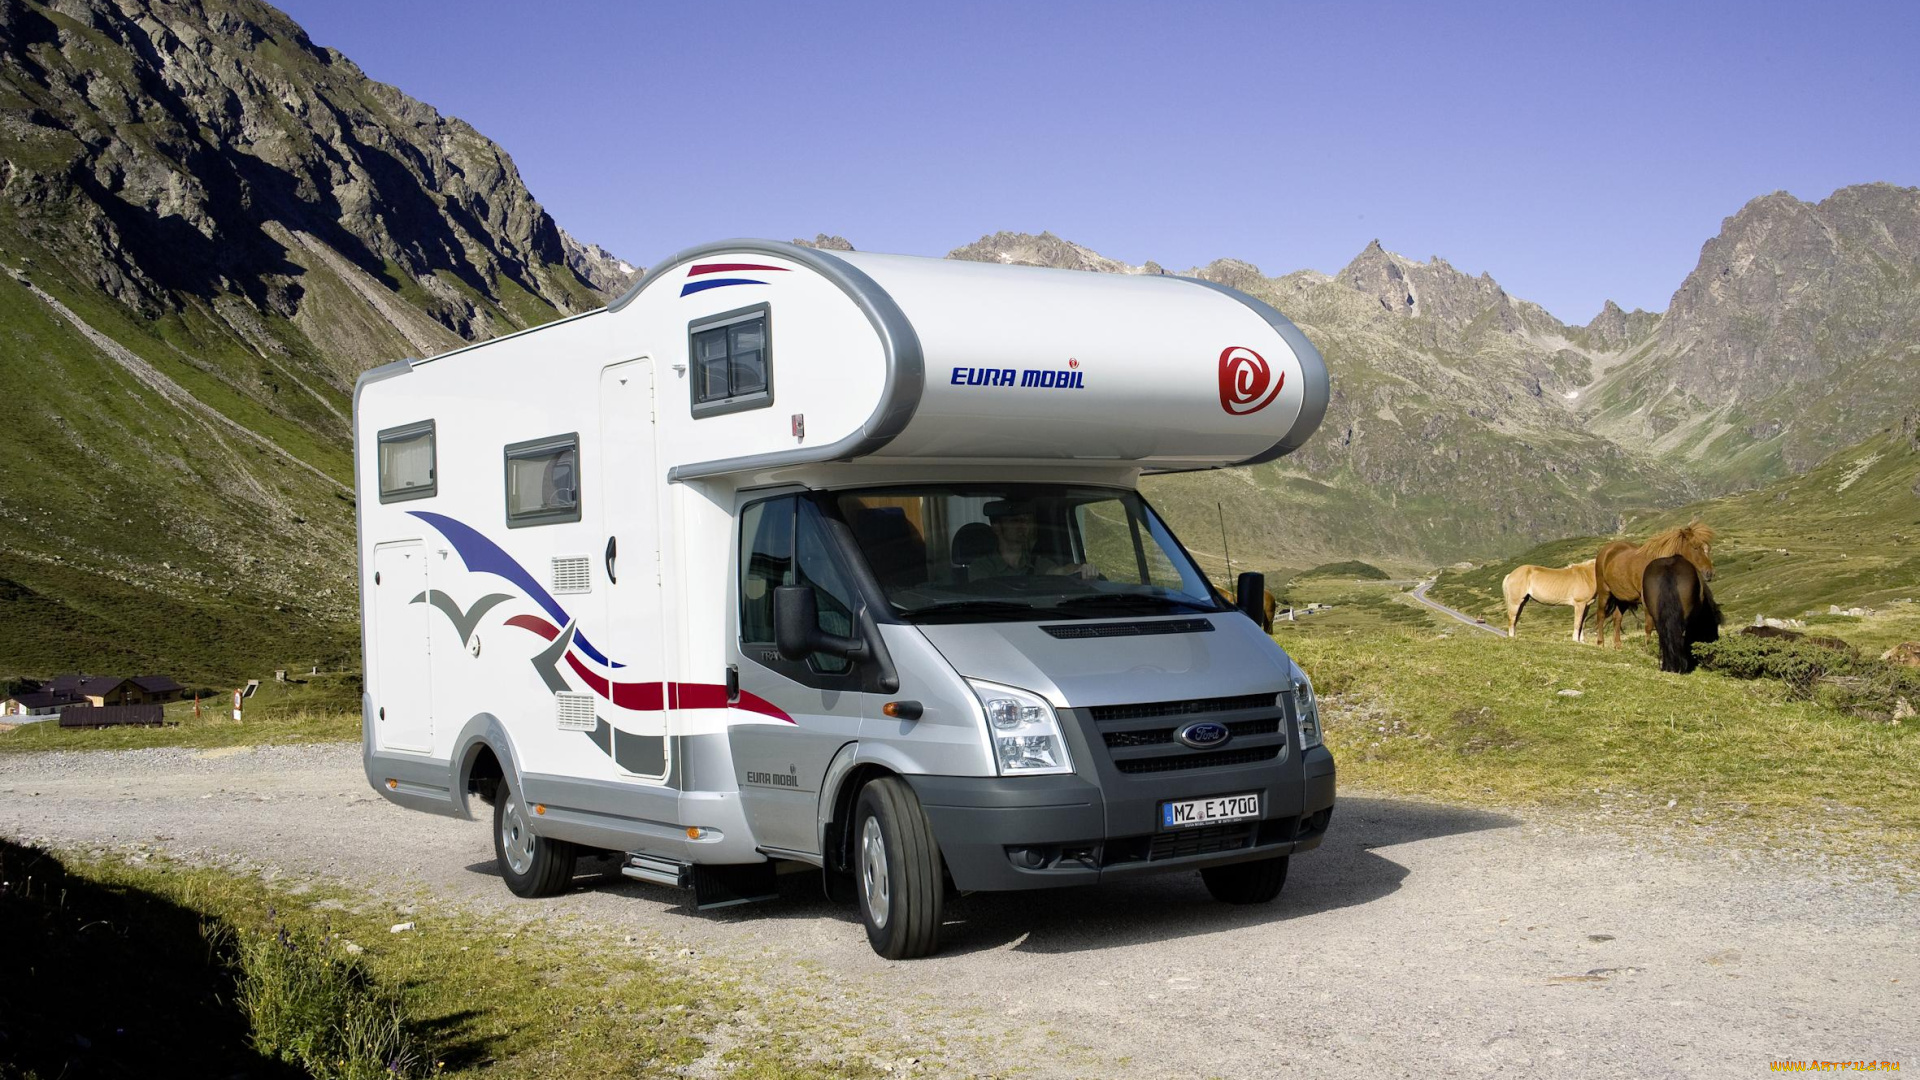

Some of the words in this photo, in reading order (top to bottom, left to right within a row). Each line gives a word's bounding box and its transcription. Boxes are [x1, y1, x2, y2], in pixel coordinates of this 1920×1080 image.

[950, 367, 1016, 387] EURA
[1020, 369, 1085, 389] MOBIL
[1195, 726, 1220, 741] Ford
[747, 771, 771, 785] EURA
[772, 773, 799, 788] MOBIL
[1174, 803, 1196, 822] MZ
[1205, 801, 1216, 819] E
[1219, 797, 1257, 817] 1700
